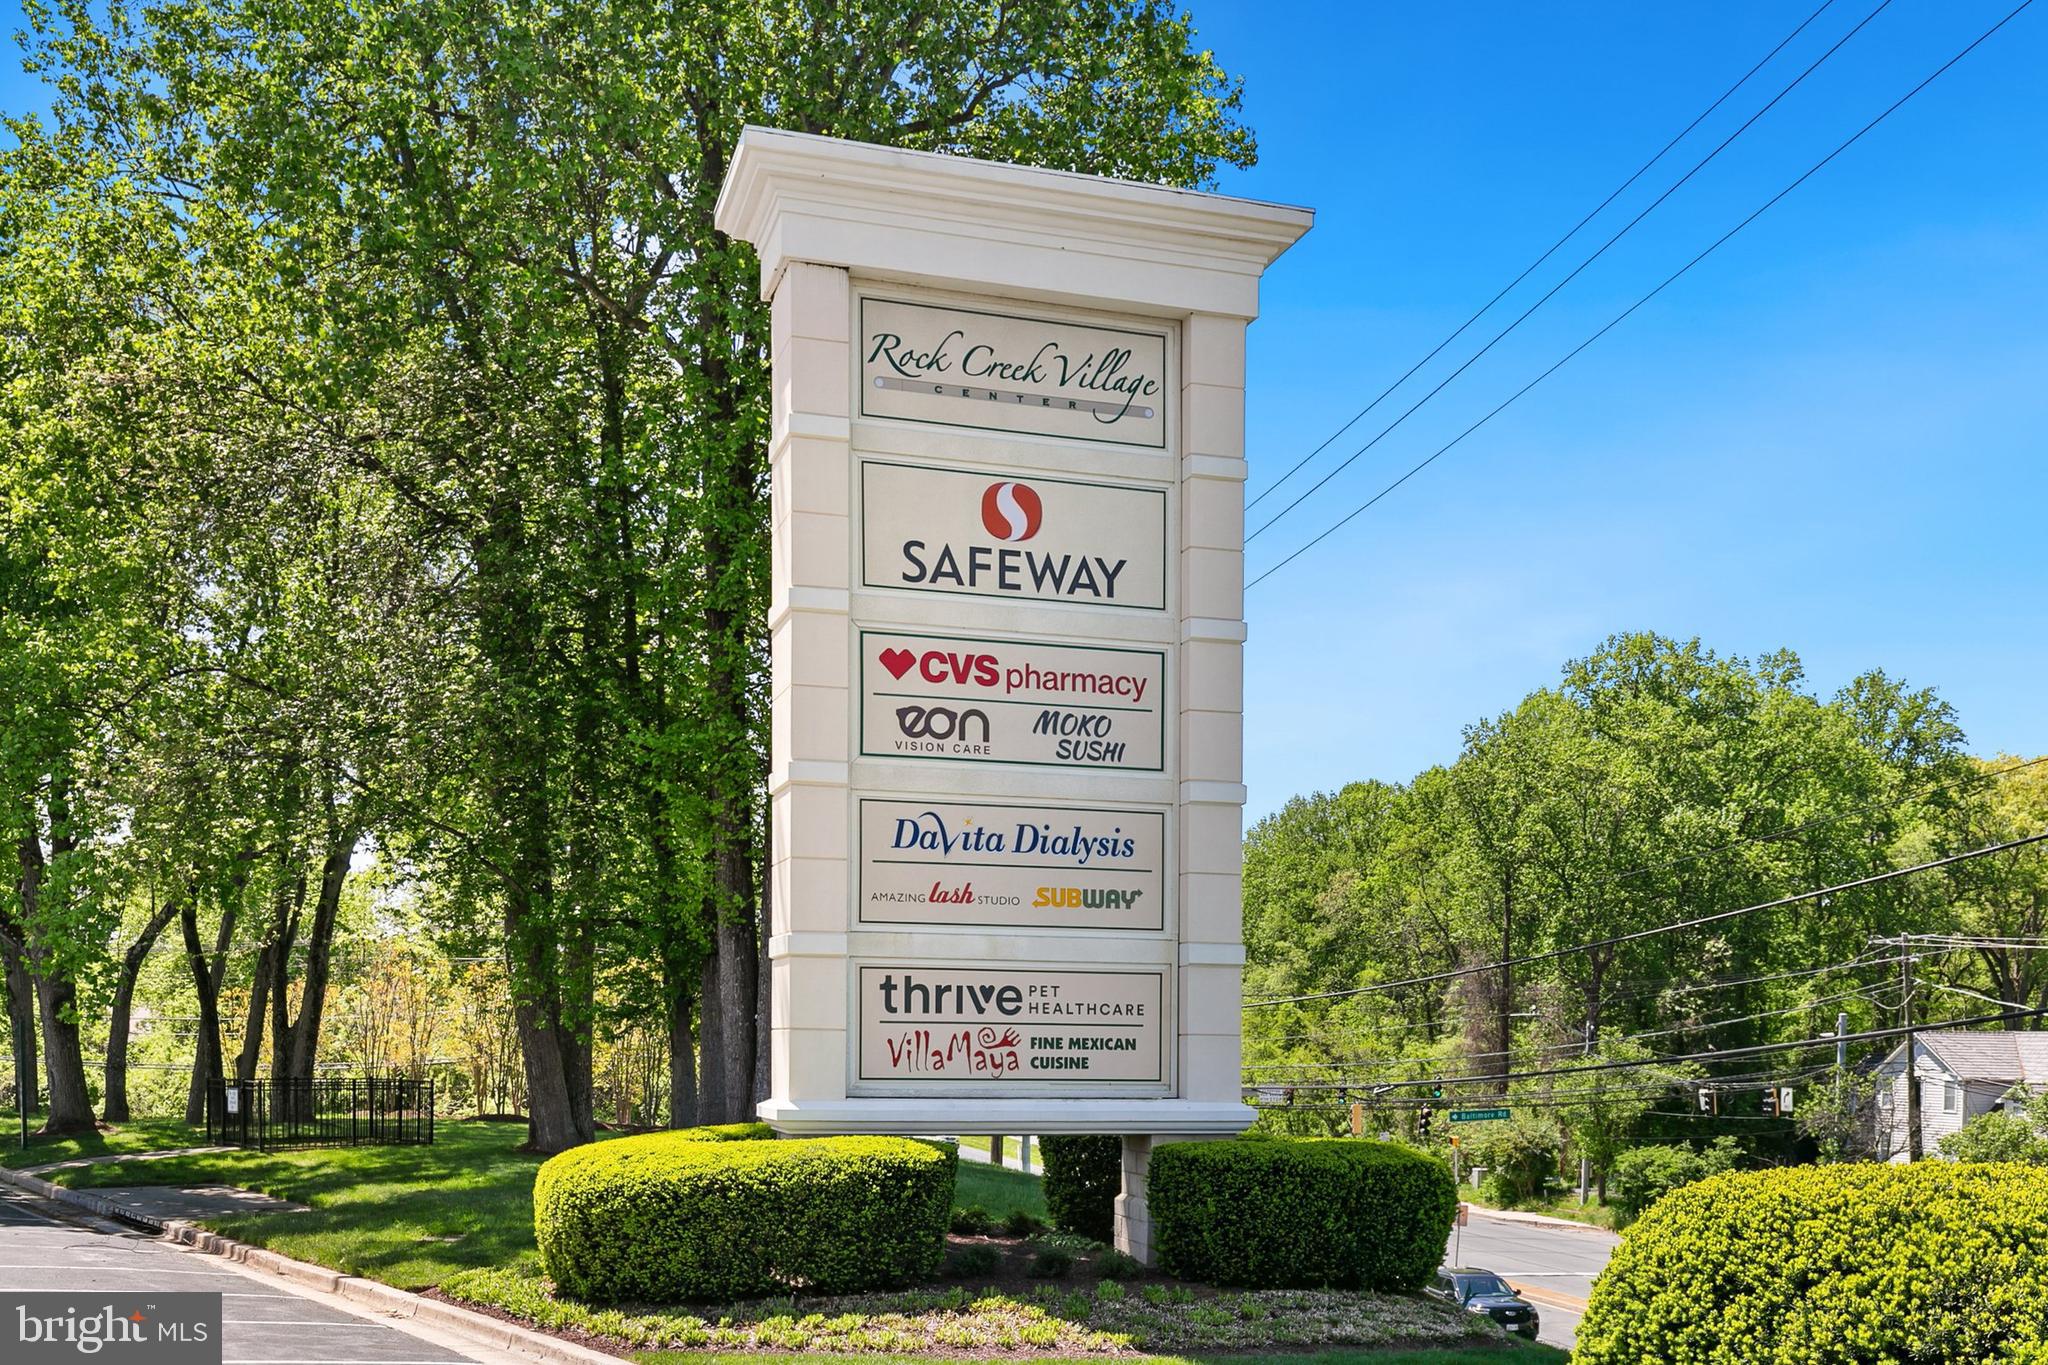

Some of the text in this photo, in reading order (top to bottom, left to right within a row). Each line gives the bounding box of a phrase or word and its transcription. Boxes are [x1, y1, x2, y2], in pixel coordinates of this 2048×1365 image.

[867, 330, 1160, 424] Rock Creek Village
[933, 384, 1078, 409] CENTER
[902, 540, 1128, 598] SAFEWAY
[919, 650, 1148, 703] CVS pharmacy
[1032, 709, 1112, 738] MOKO
[895, 740, 991, 755] VISION CARE
[1055, 738, 1127, 763] SUSHI
[891, 811, 1135, 865] DaVita Dialysis
[871, 880, 1021, 907] AMAZING lash STUDIO
[1031, 886, 1144, 910] SUBWAY
[879, 974, 1023, 1016] thrive
[1028, 985, 1060, 998] PET
[1028, 1002, 1145, 1016] HEALTHCARE
[1030, 1036, 1137, 1051] FINE MEXICAN
[1030, 1056, 1090, 1070] CUISINE
[1461, 1112, 1495, 1120] Baltimore
